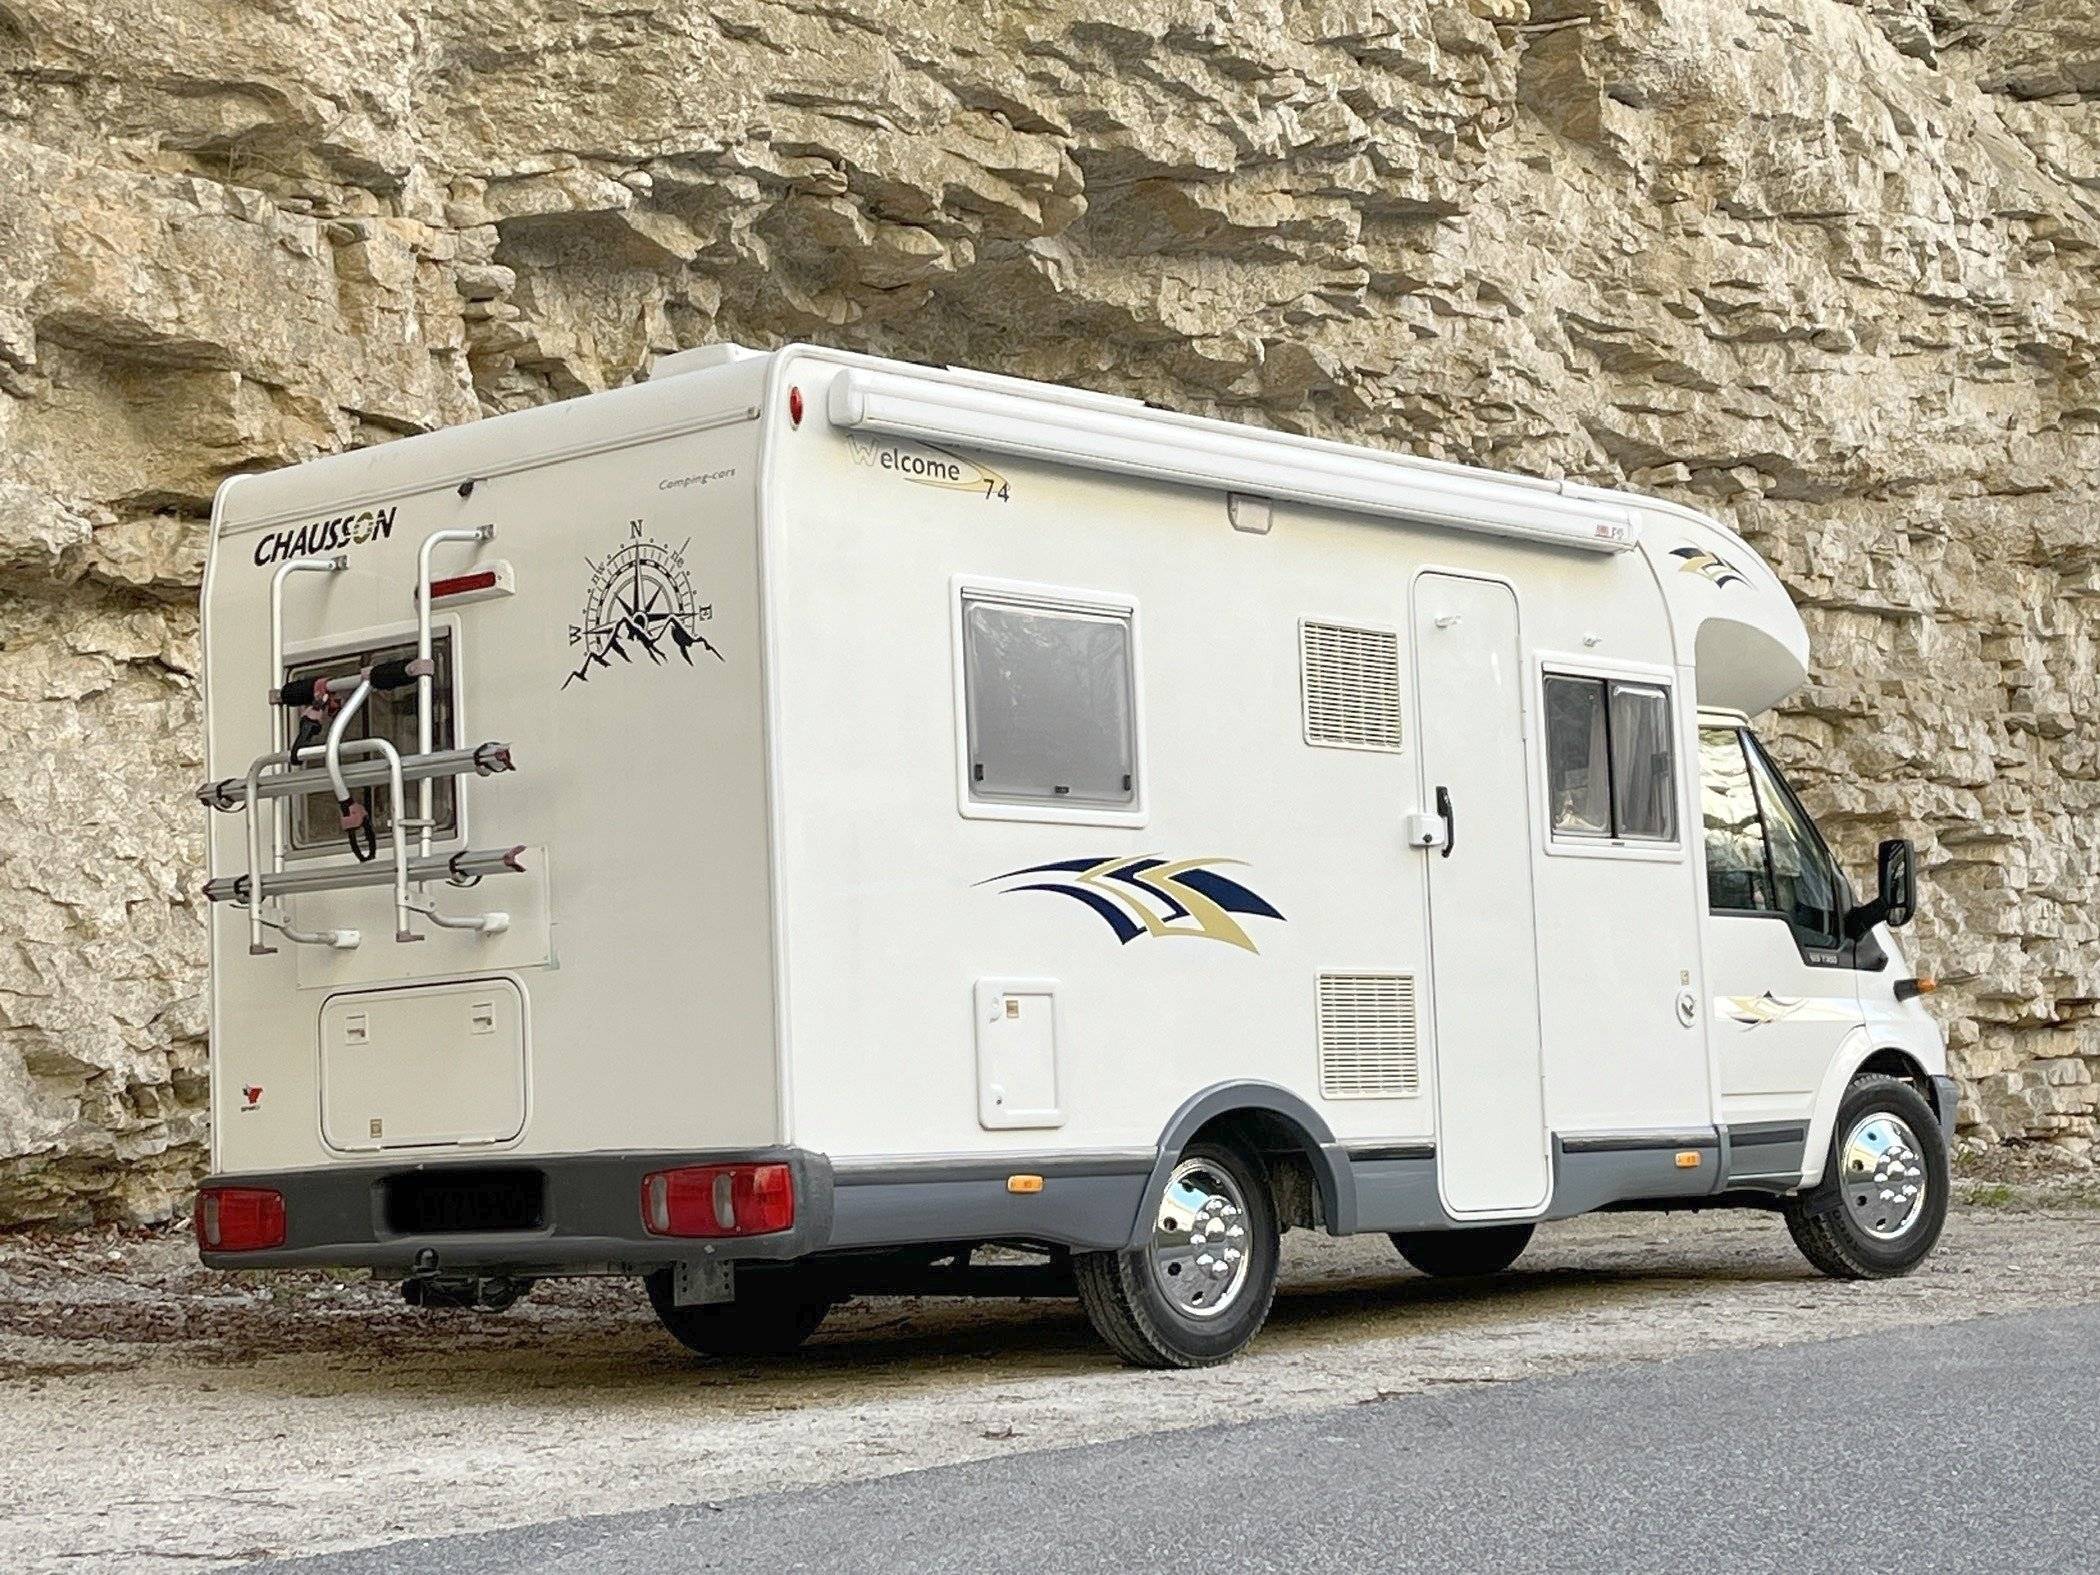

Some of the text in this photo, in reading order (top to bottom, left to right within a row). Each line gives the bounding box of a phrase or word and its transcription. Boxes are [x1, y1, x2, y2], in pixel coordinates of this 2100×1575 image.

[659, 469, 736, 491] Camping-cars
[847, 434, 1011, 504] Welcome 74
[254, 506, 398, 567] CHAUSSON
[629, 518, 644, 540] N
[698, 603, 713, 622] E
[568, 624, 583, 647] W
